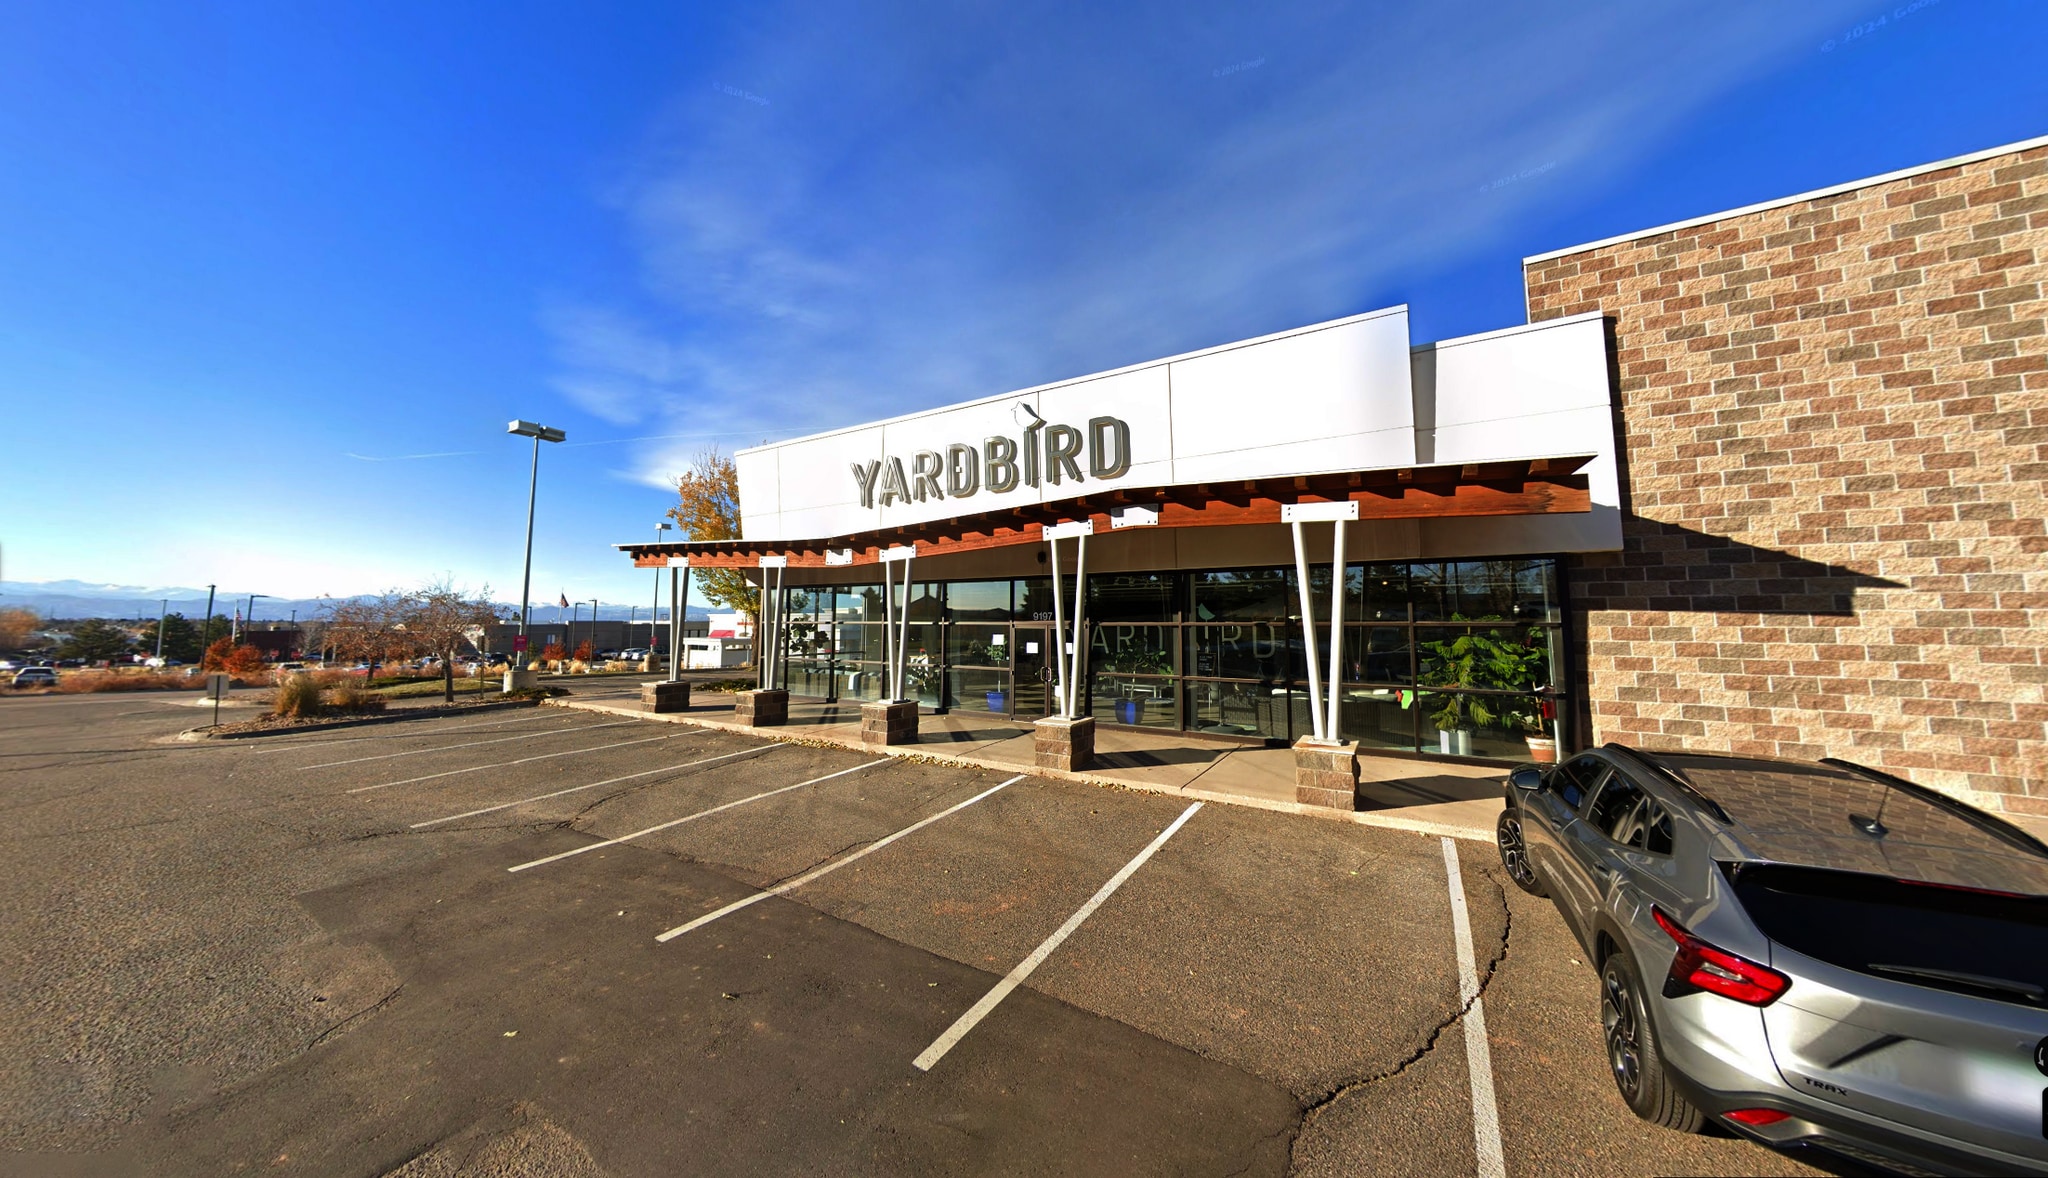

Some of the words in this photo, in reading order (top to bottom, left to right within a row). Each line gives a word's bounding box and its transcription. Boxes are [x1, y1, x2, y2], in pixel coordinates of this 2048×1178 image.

[850, 413, 1131, 510] YARDBIRD
[1032, 611, 1053, 621] 9197
[1803, 1076, 1847, 1097] TRAX
